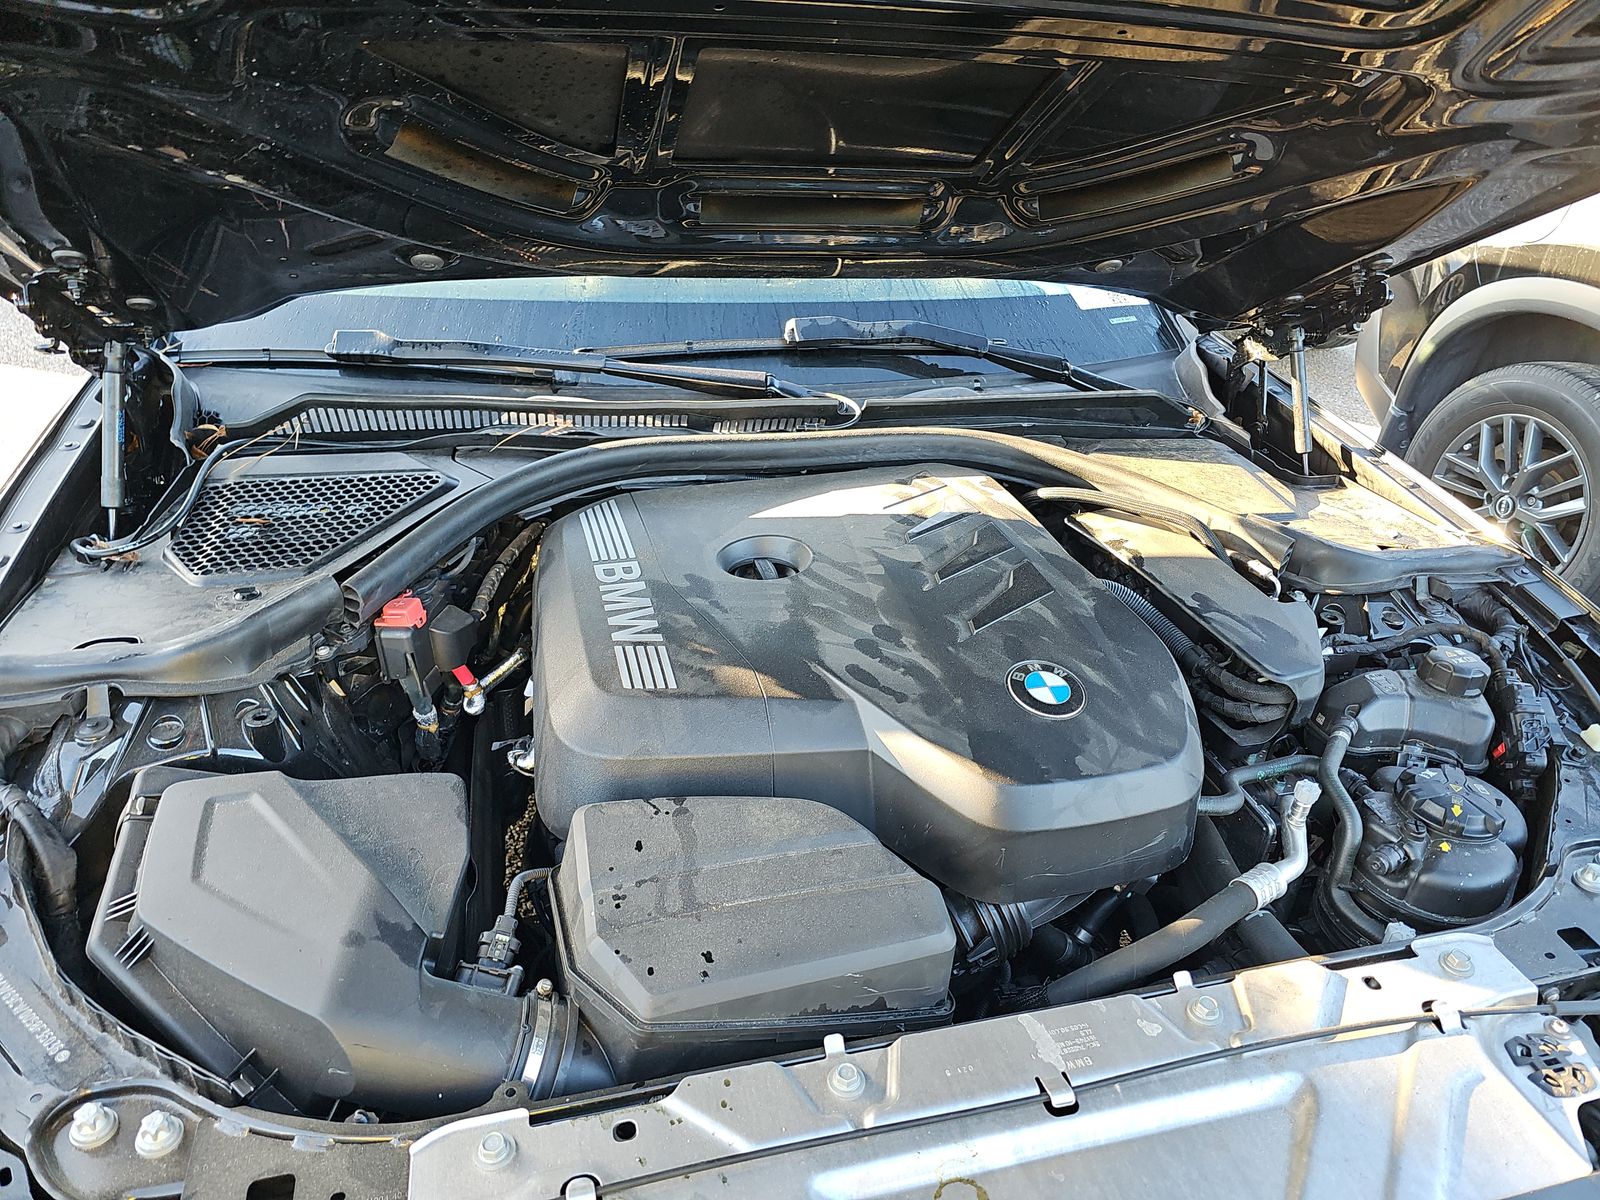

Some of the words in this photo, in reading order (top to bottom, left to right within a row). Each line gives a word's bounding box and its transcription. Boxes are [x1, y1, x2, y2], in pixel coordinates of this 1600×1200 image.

[593, 560, 663, 642] BMW
[1012, 663, 1067, 682] BMW
[1065, 1056, 1093, 1071] BMW
